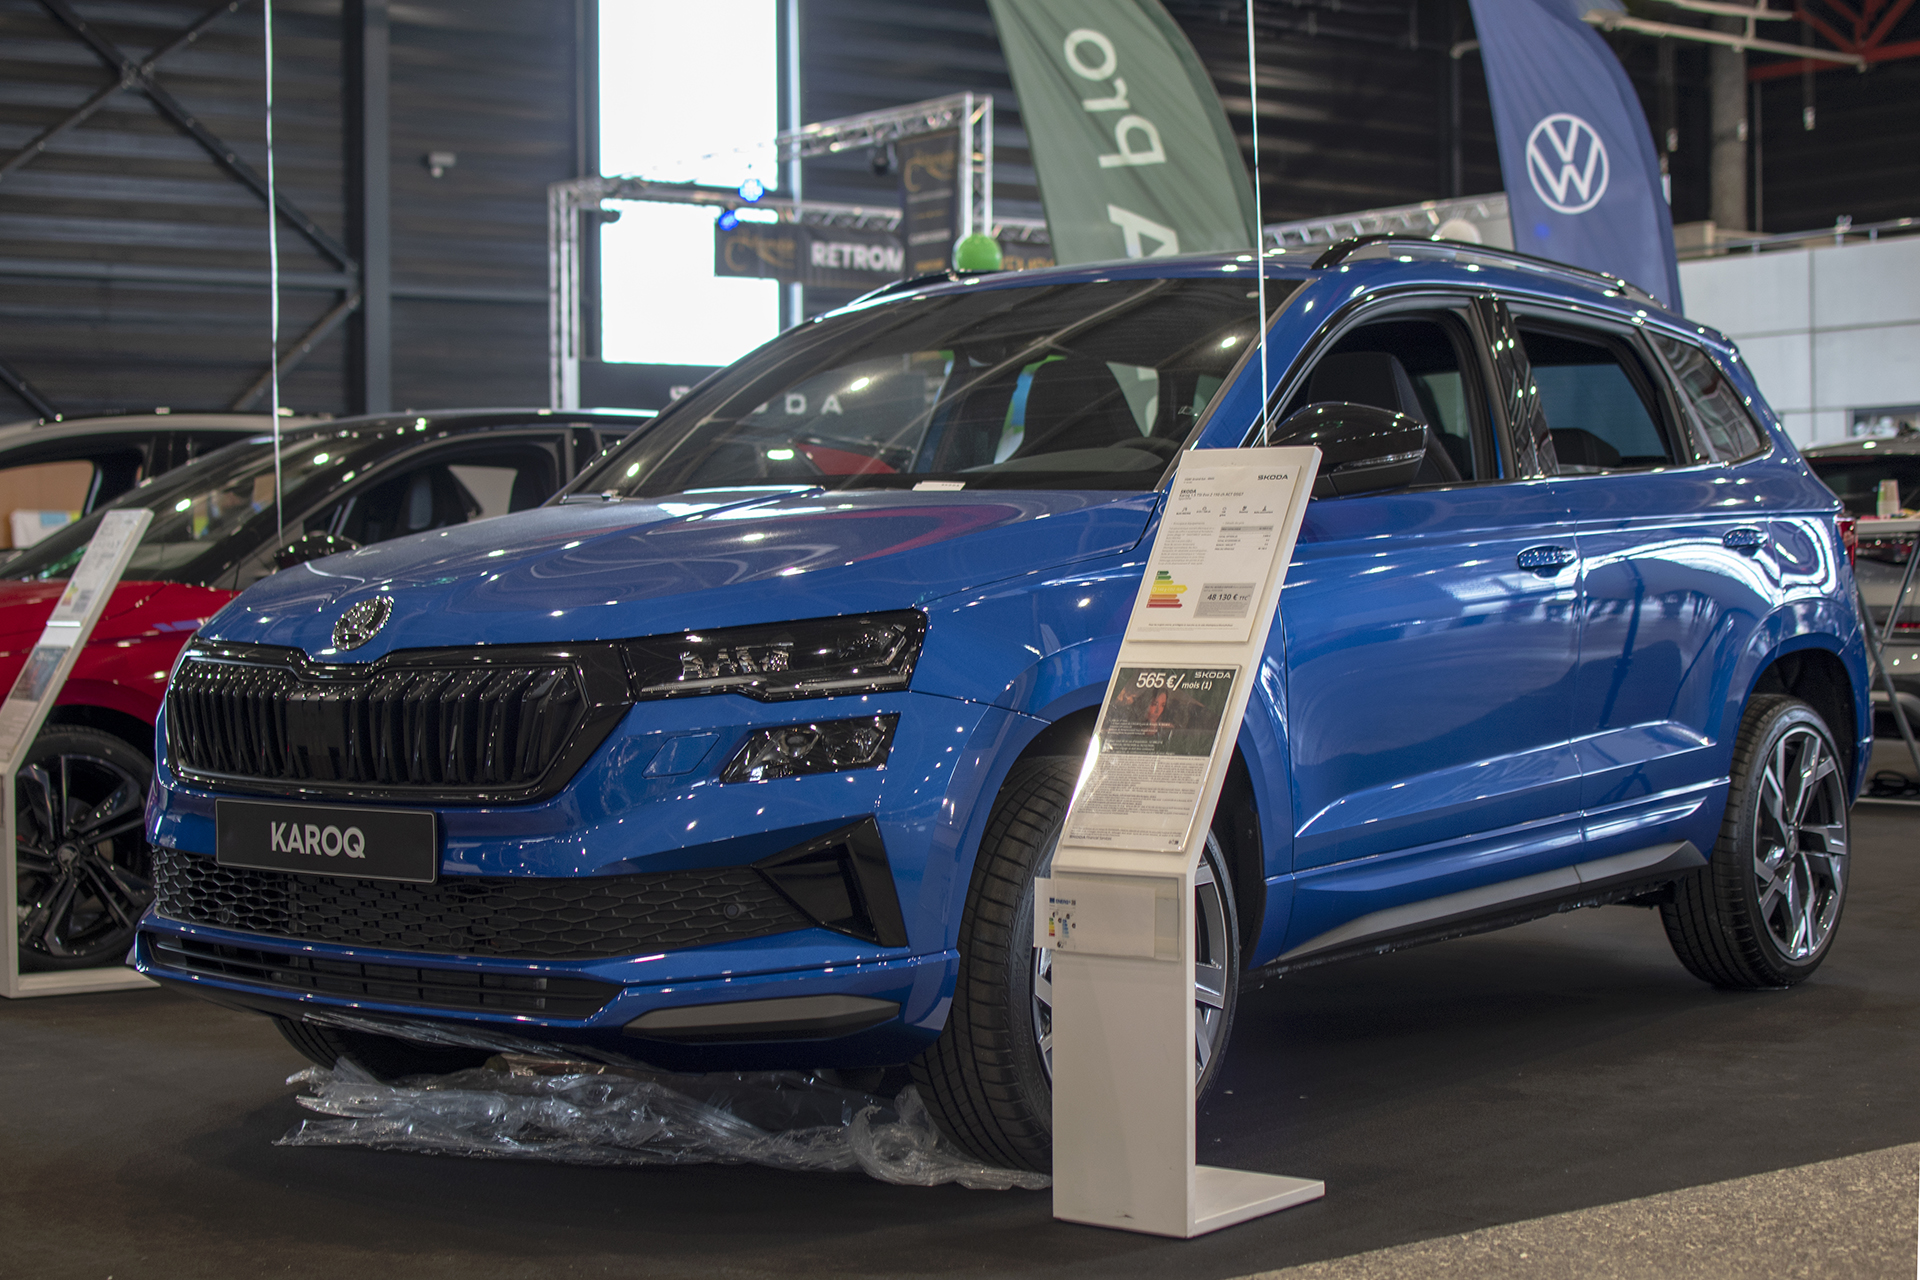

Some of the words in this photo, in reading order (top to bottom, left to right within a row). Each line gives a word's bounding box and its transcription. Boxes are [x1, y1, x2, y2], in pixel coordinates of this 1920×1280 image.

[1136, 672, 1166, 689] 565
[1181, 681, 1200, 690] mois
[1200, 681, 1213, 691] (1)
[270, 821, 366, 859] KAROQ
